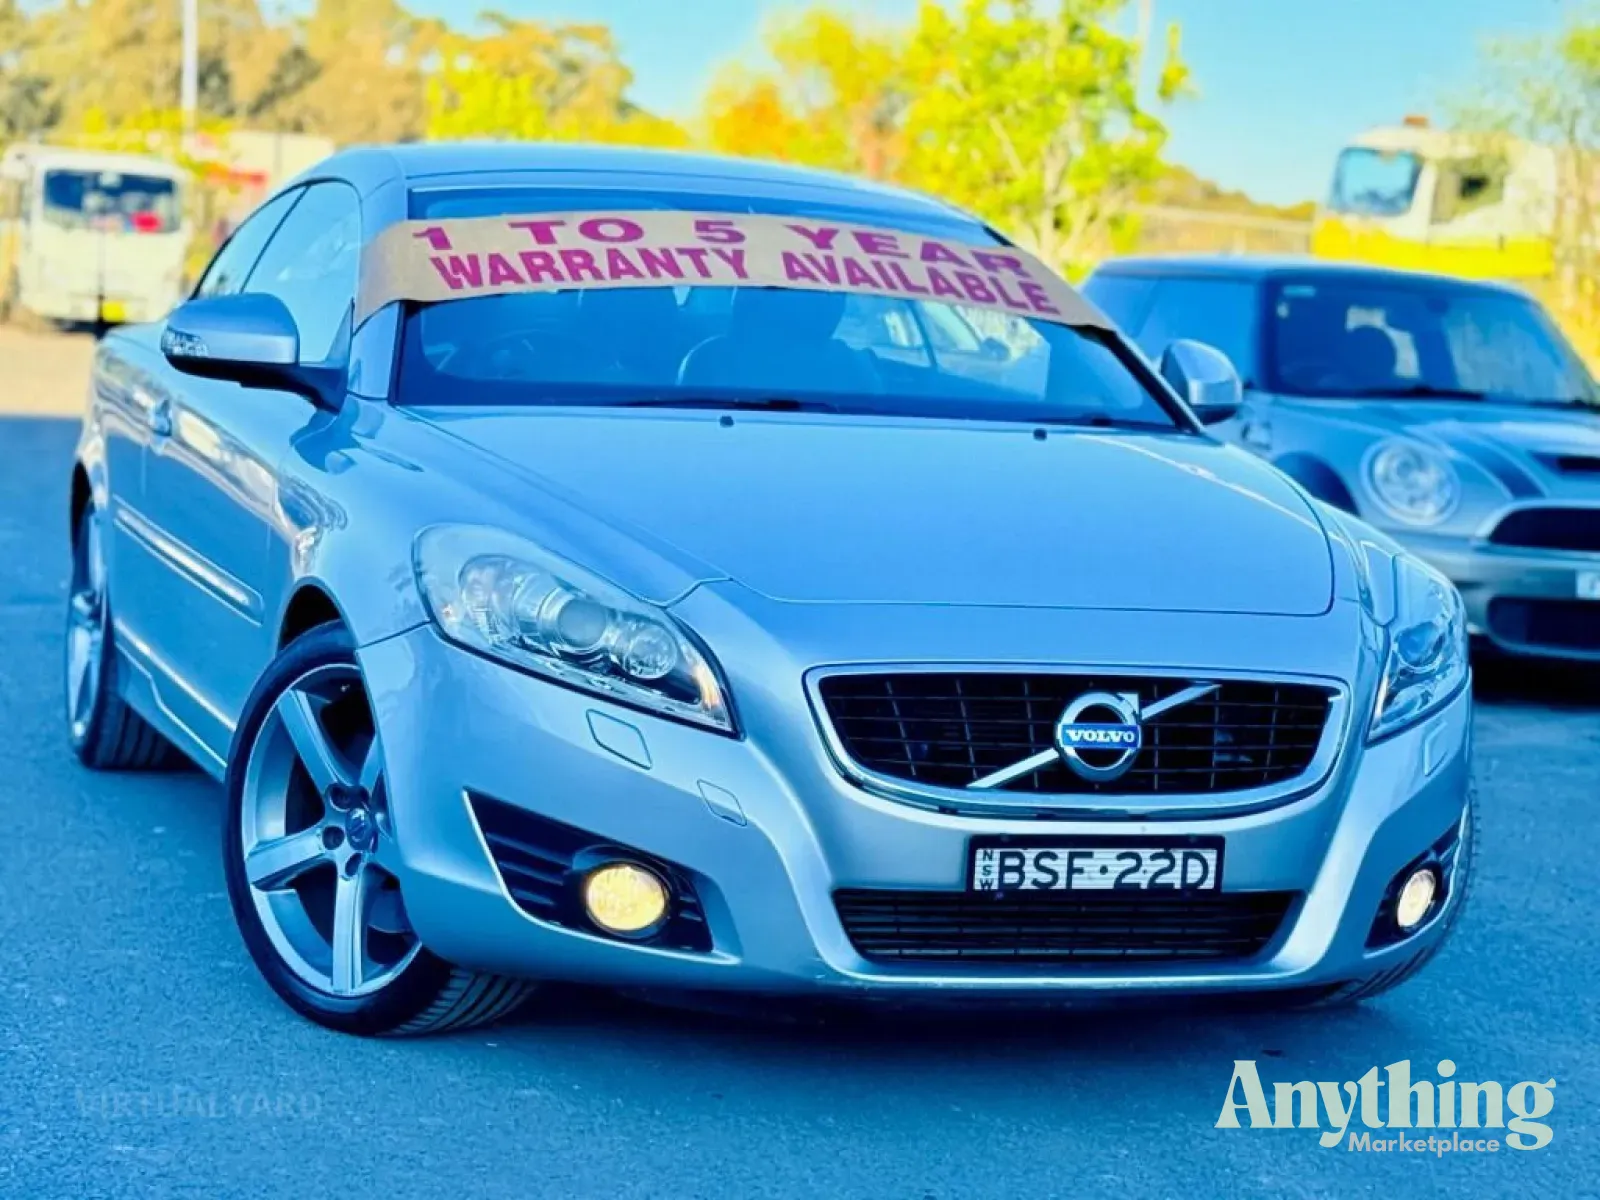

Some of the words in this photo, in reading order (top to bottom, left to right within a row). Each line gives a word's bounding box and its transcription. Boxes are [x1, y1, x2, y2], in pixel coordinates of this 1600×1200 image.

[413, 227, 452, 250] 1
[508, 218, 644, 245] TO
[694, 219, 746, 243] 5
[785, 224, 1032, 278] YEAR
[430, 247, 749, 290] WARRANTY
[781, 250, 1061, 316] AVAILABLE
[1066, 728, 1135, 743] VOLVO
[979, 850, 994, 890] NSW
